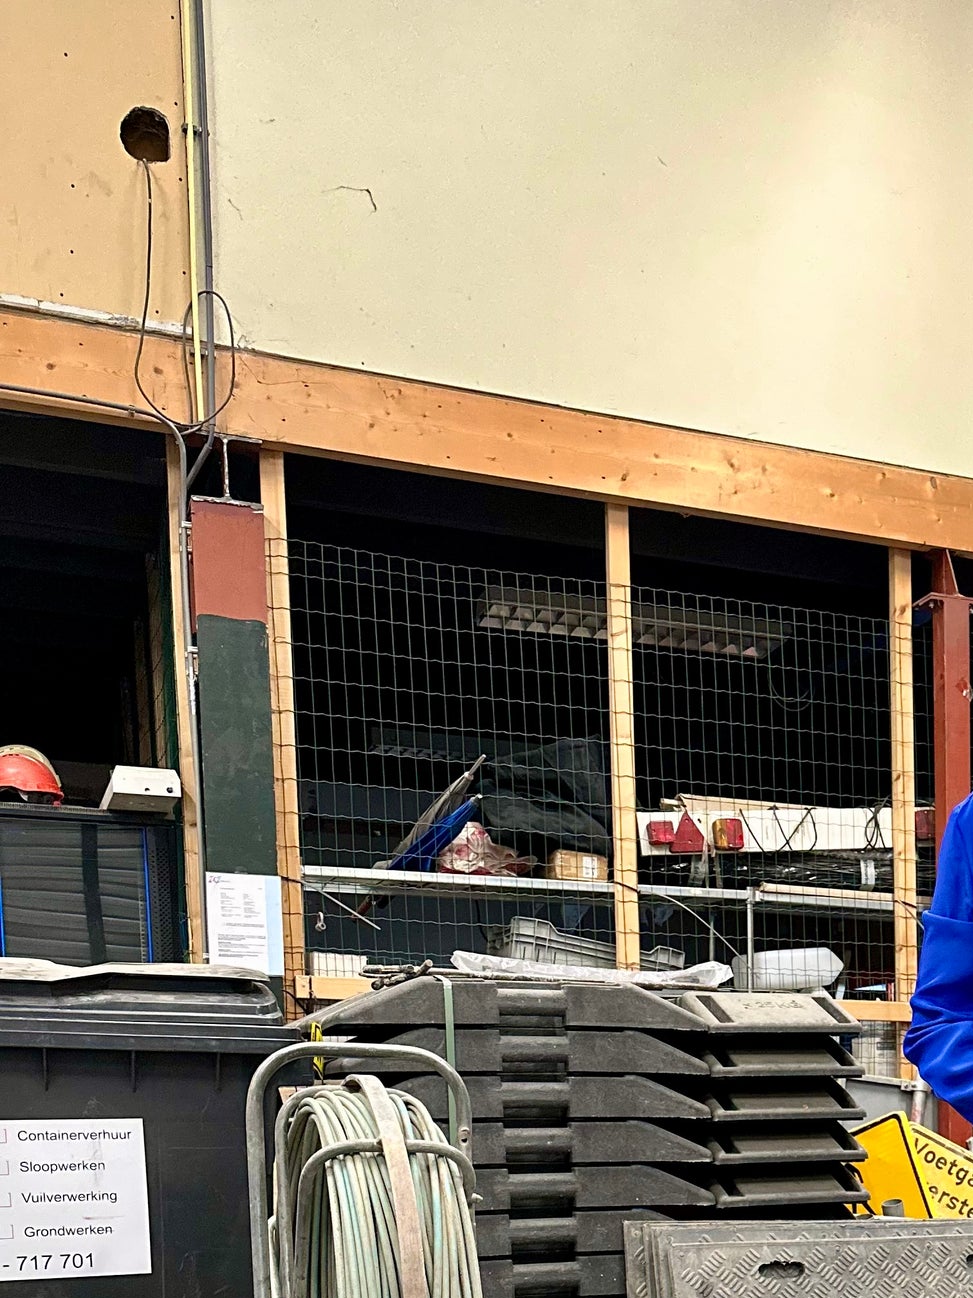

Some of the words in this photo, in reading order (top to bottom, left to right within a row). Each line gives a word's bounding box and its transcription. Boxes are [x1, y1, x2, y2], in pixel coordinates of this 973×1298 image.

[17, 1130, 132, 1142] Containerverhuur
[19, 1161, 106, 1174] Sloopwerken
[21, 1191, 118, 1204] Vuilverwerking
[24, 1225, 113, 1238] Grondwerken
[16, 1254, 53, 1271] 717
[60, 1253, 94, 1269] 701
